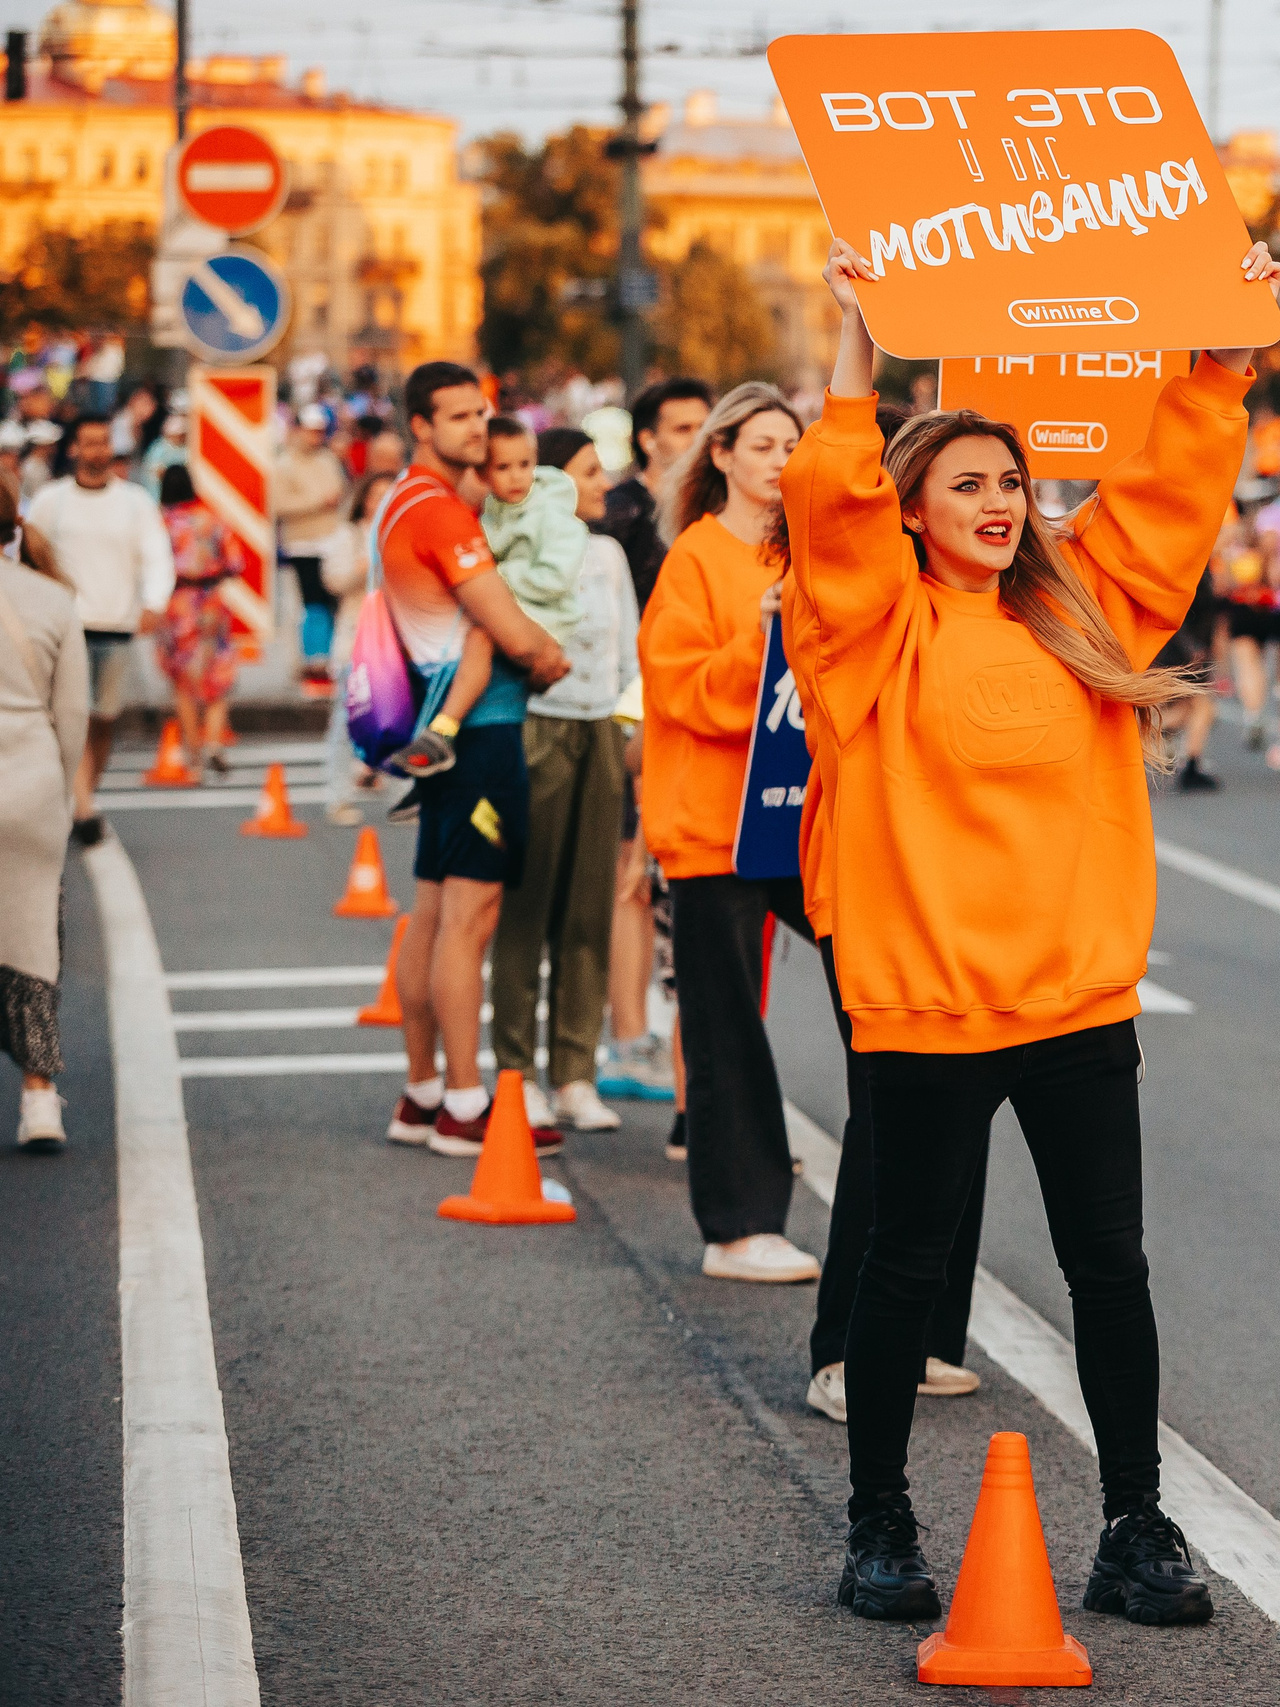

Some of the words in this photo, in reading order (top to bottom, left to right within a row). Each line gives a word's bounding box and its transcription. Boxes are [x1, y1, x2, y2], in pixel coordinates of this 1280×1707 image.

[819, 90, 976, 132] ВОТ
[1006, 86, 1163, 127] ЭТО
[957, 138, 985, 183] У
[1000, 136, 1071, 181] ВАС
[869, 156, 1208, 277] МОТИВАЦИЯ
[1018, 304, 1103, 322] Winline
[1035, 428, 1086, 445] Winline
